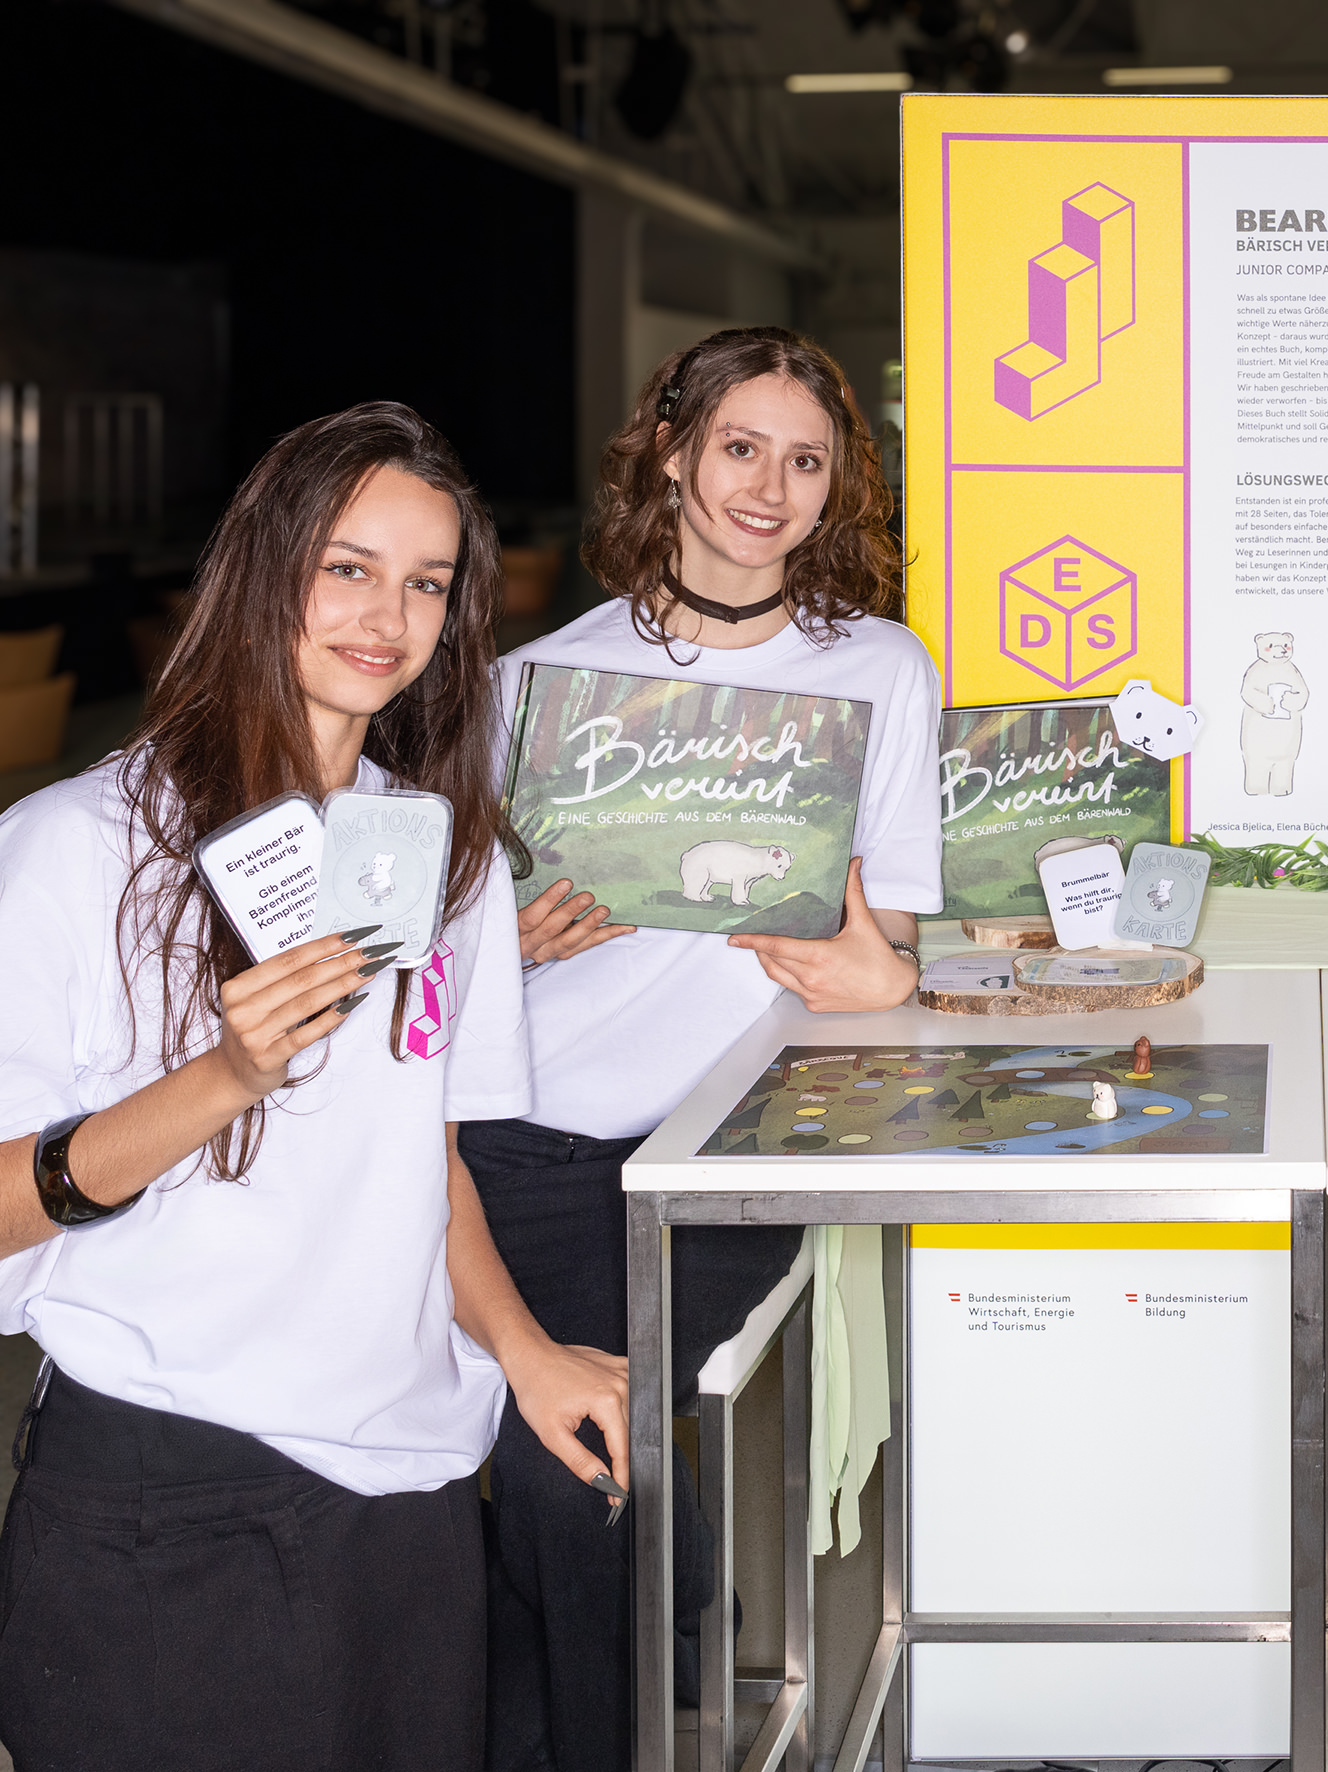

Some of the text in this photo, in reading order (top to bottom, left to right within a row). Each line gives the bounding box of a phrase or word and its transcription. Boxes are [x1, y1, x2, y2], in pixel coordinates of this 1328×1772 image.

[1237, 237, 1302, 252] BÄRISCH
[1236, 265, 1282, 275] JUNIOR
[1237, 293, 1255, 302] Was
[1256, 293, 1268, 302] als
[1270, 294, 1307, 304] spontane
[1309, 293, 1326, 303] Idee
[1237, 306, 1265, 315] schnell
[1279, 307, 1302, 315] etwas
[1236, 496, 1281, 506] Entstanden
[1283, 497, 1292, 506] ist
[1294, 498, 1306, 506] ein
[1236, 510, 1248, 518] mit
[1251, 509, 1261, 519] 28
[1264, 509, 1291, 519] Seiten,
[1293, 510, 1307, 519] das
[1054, 558, 1081, 592] E
[1020, 614, 1116, 649] D S
[551, 715, 812, 805] Bärisch
[940, 730, 1130, 825] Bärisch
[641, 770, 794, 808] vereint
[993, 771, 1118, 813] vereint
[558, 809, 807, 827] EINE GESCHICHTE AUS DEM BÄRENWALD
[942, 807, 1132, 842] NE GESCHICHTE AUS DEM BÄRENWALD
[332, 808, 443, 852] AKTIONS
[1207, 822, 1241, 832] Jessica
[1243, 822, 1275, 834] Bjelica,
[1276, 822, 1301, 832] Elena
[225, 823, 306, 873] Ein kleiner Bär
[243, 845, 302, 879] ist traurig.
[1133, 852, 1208, 880] AKTIONS
[258, 864, 314, 900] Gib einem
[1061, 871, 1110, 888] Brummelbär
[248, 875, 318, 920] Bärenfreund
[1064, 886, 1115, 903] Was hilft dir,
[257, 888, 320, 930] Komplimen
[1060, 902, 1083, 912] wenn
[1084, 897, 1097, 908] du
[1084, 904, 1104, 915] bist?
[296, 908, 316, 923] ihn
[277, 923, 314, 949] aufzuh
[1122, 915, 1187, 941] KARTE
[969, 1293, 1071, 1303] Bundesministerium
[1146, 1294, 1248, 1303] Bundesministerium
[969, 1307, 1075, 1319] Wirtschaft, Energie
[1146, 1308, 1186, 1319] Bildung
[968, 1322, 1046, 1331] und Tourismus
